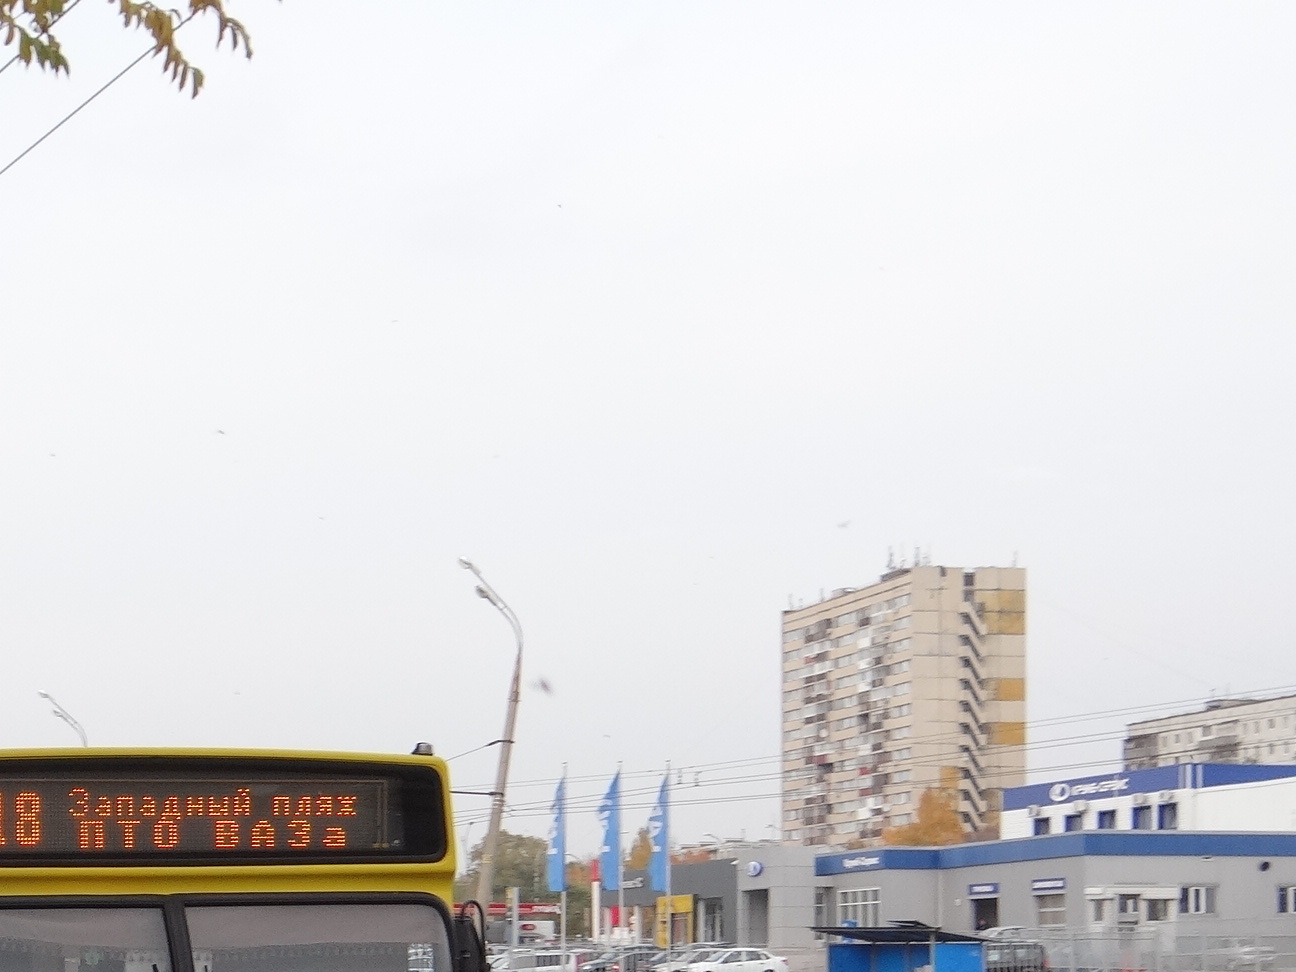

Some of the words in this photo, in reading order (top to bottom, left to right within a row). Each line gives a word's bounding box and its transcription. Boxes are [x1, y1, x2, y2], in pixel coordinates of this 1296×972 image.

[68, 788, 251, 820] Западный
[273, 796, 357, 816] пляж
[79, 820, 179, 849] ПТО
[215, 819, 346, 848] ВАЗа
